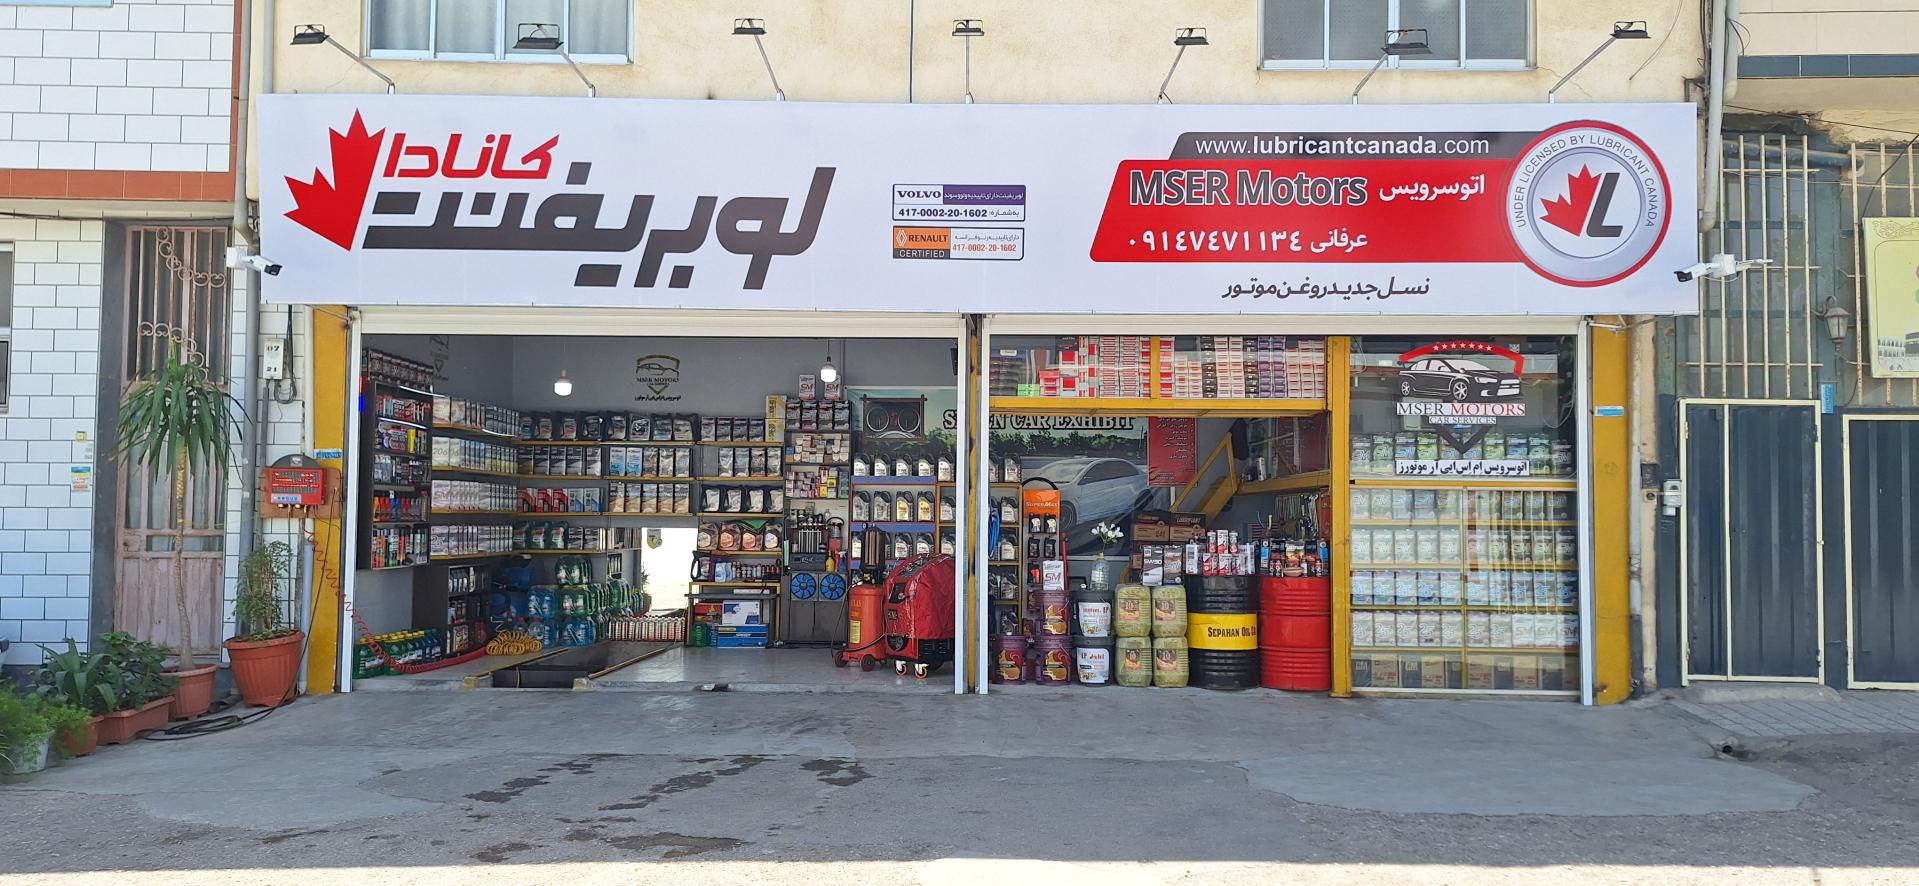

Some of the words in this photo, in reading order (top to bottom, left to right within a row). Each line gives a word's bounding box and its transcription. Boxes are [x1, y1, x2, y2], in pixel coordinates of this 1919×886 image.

[1195, 136, 1489, 155] www.lubricantcanada.com
[1570, 134, 1587, 146] BY
[383, 132, 560, 180] کانادا
[1519, 139, 1567, 184] LICENSED
[1590, 134, 1650, 176] LUBRICANT
[897, 190, 942, 199] VOLVO
[1129, 169, 1229, 206] MSER
[1236, 169, 1368, 206] Motors
[1379, 173, 1486, 202] اتوسرویس
[1513, 186, 1527, 228] UNDER
[1644, 177, 1659, 228] CANADA
[898, 208, 988, 218] 417-0002-20-1602
[362, 162, 837, 290] لوبریفنت
[908, 234, 949, 243] RENAULT
[1310, 229, 1368, 253] عرفانی
[899, 249, 945, 258] CERTIFIED
[952, 243, 1017, 252] 417-0002-20-1602
[1397, 403, 1444, 415] MSER
[1450, 403, 1526, 416] MOTORS
[1052, 414, 1135, 430] EXHIBIT
[1429, 416, 1450, 424] CAR
[1451, 416, 1497, 425] SERVICES
[1484, 461, 1527, 476] اتوسرویس
[1207, 627, 1240, 637] SEPAHAN
